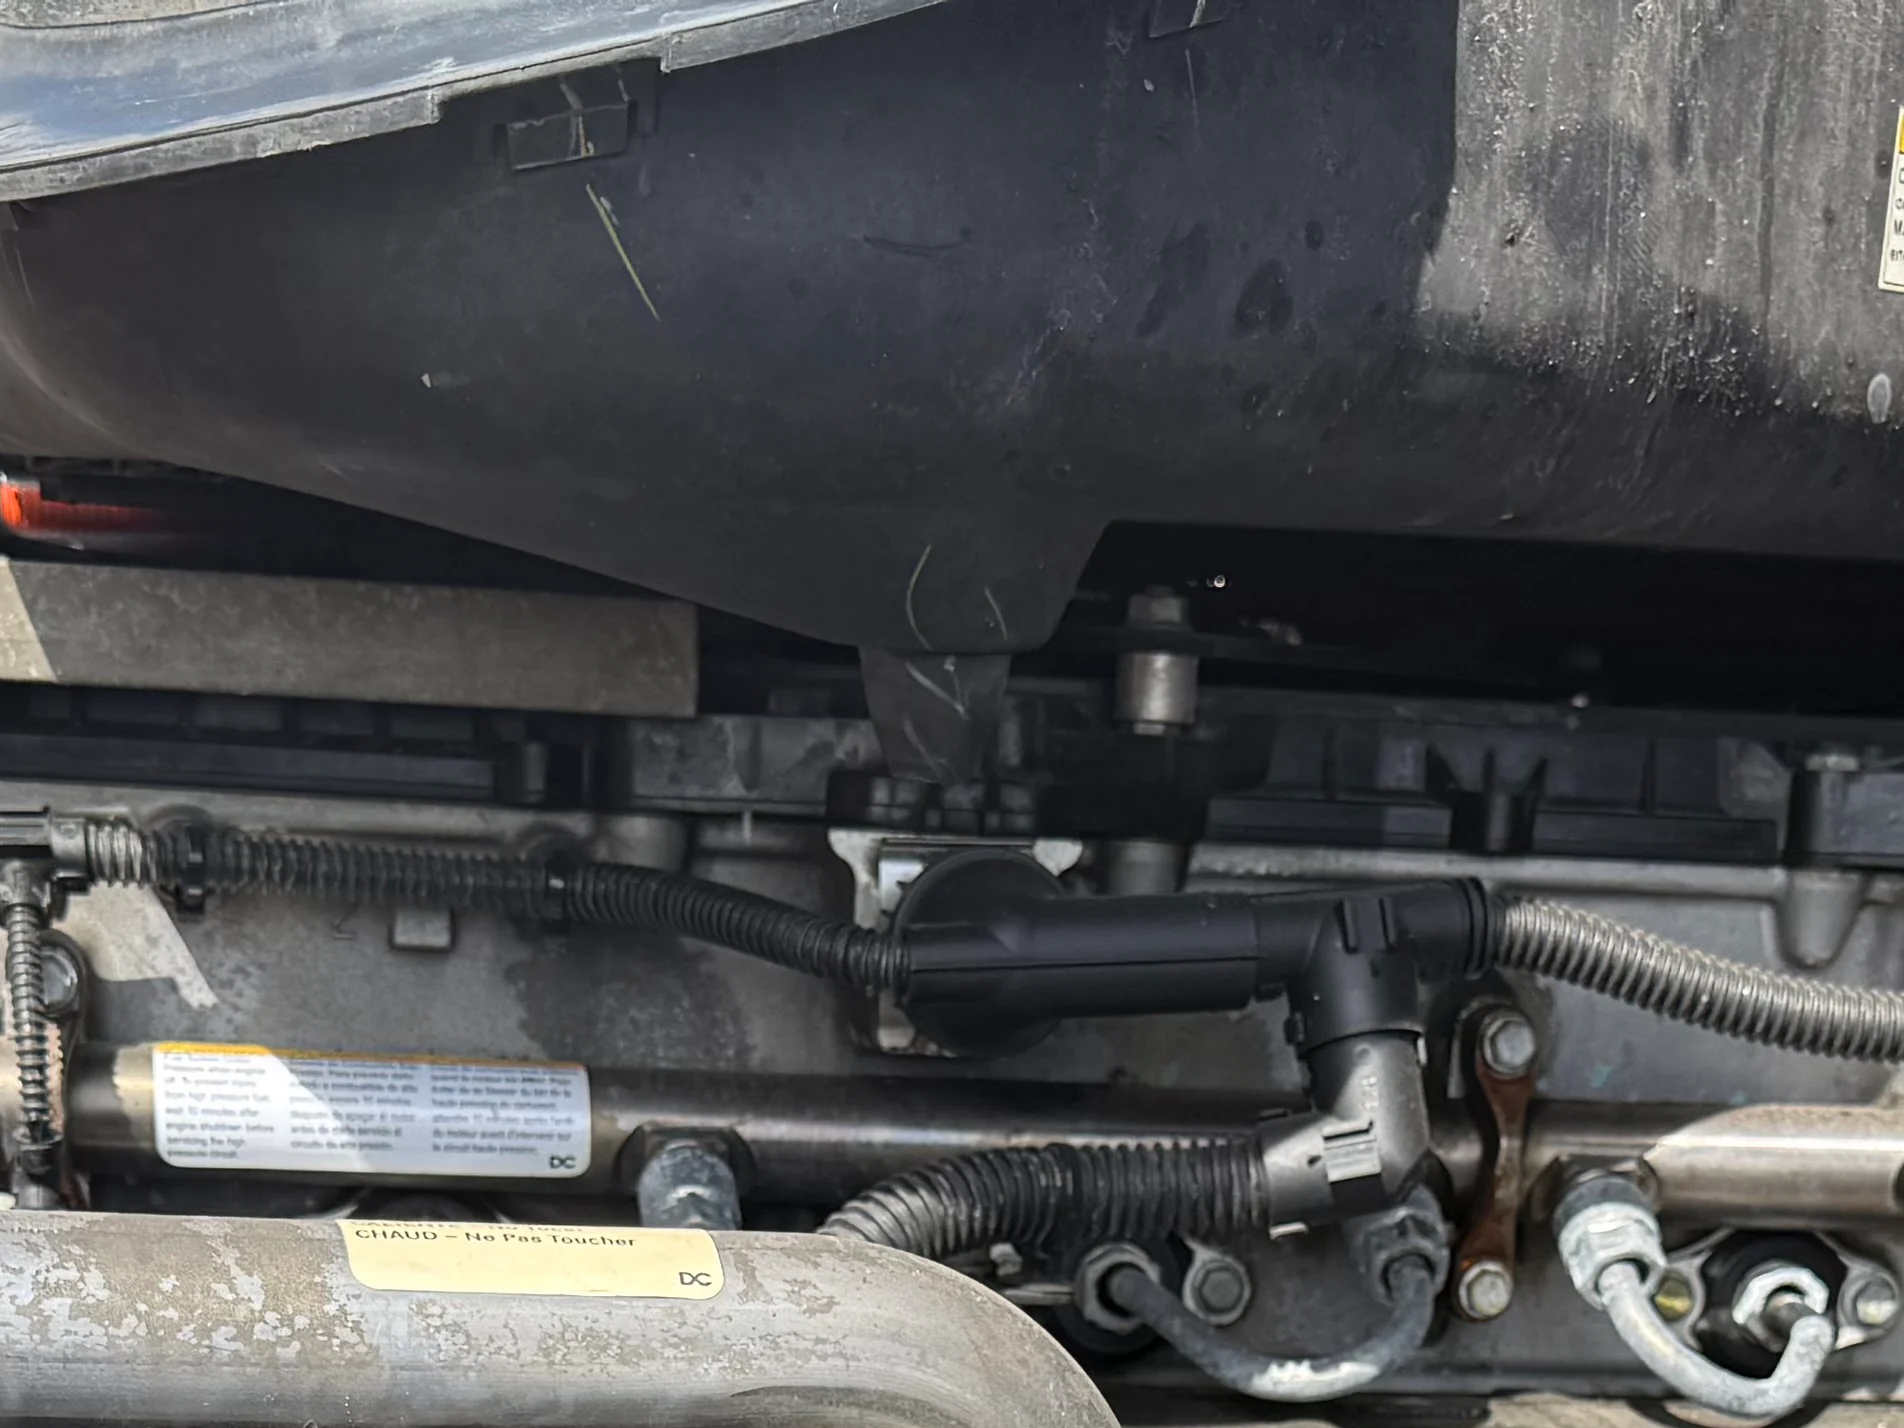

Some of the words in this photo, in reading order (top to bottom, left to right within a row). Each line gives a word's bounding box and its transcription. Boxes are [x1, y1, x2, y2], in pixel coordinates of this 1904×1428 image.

[549, 1155, 576, 1169] DC
[355, 1228, 438, 1242] CHAUD
[465, 1232, 496, 1243] Ne
[503, 1232, 542, 1244] Pas
[551, 1233, 638, 1248] Toucher
[678, 1271, 712, 1287] DC
